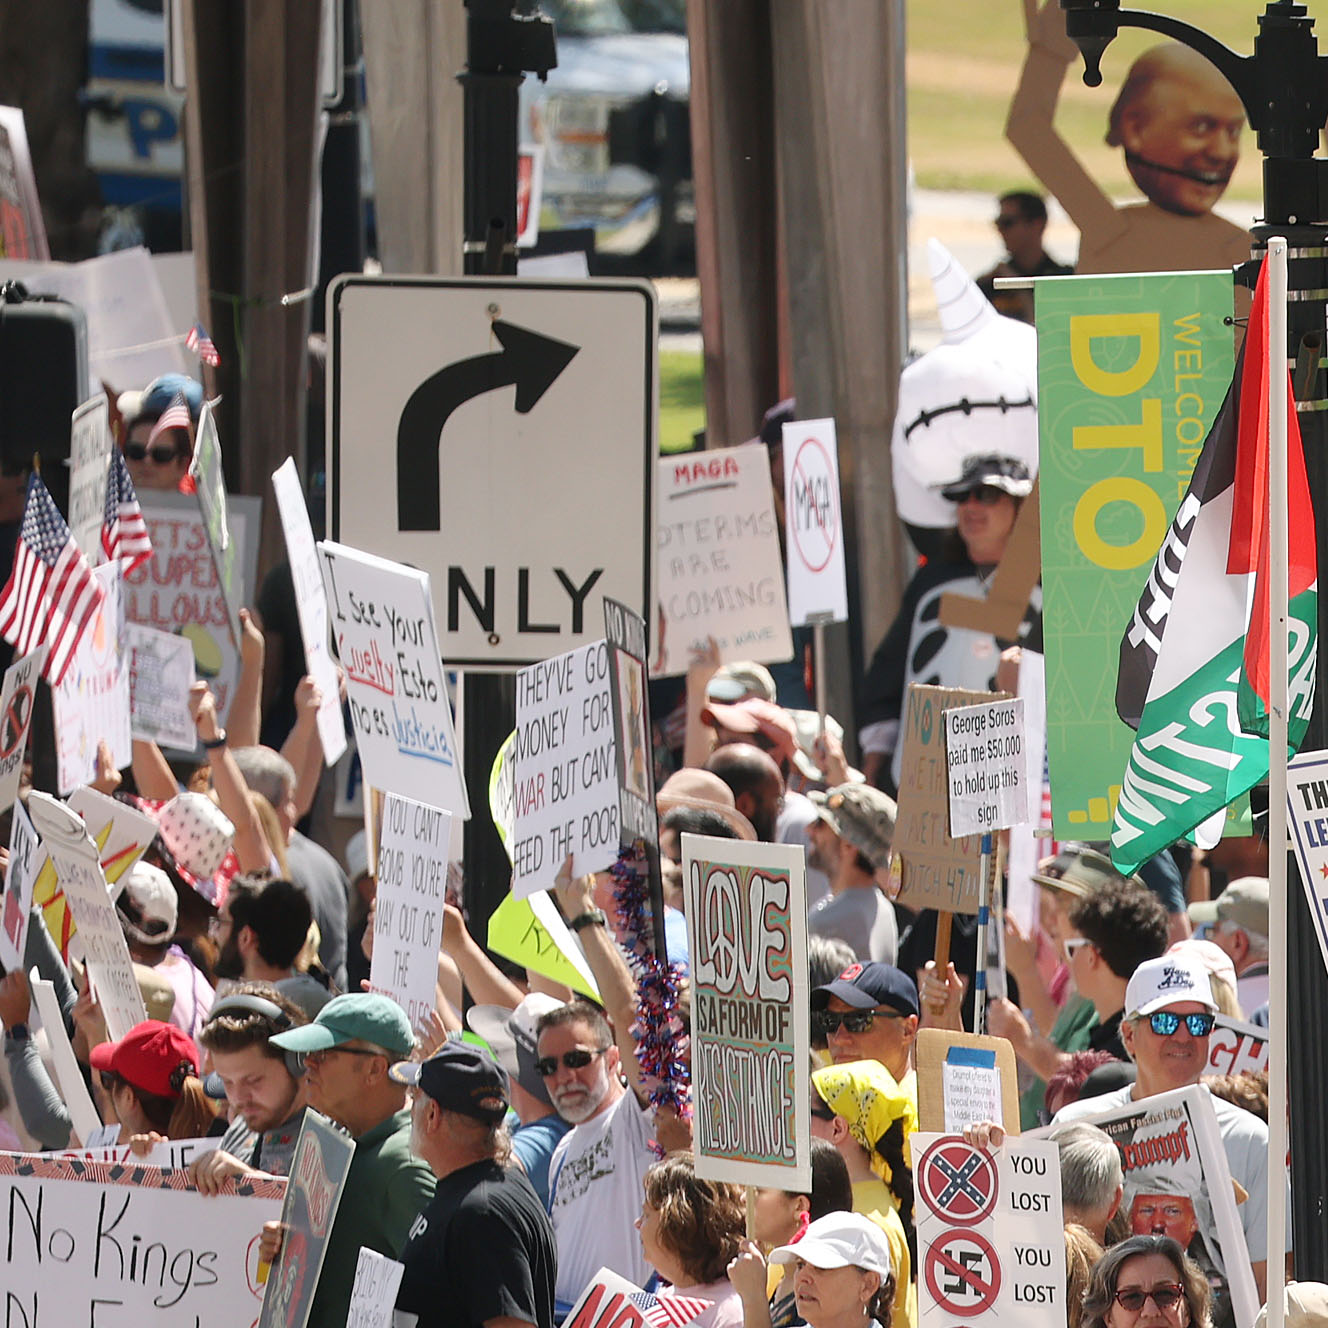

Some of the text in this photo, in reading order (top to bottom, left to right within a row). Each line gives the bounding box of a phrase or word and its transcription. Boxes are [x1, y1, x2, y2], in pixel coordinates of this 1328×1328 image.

[1069, 312, 1168, 570] DTO
[952, 709, 1015, 736] George Soros
[949, 735, 1019, 772] paid me $50,000
[953, 767, 1018, 796] to hold up this
[977, 802, 997, 825] sign
[1010, 1155, 1046, 1176] YOU
[1011, 1191, 1050, 1212] LOST
[6, 1185, 219, 1308] No Kings
[1014, 1246, 1051, 1267] YOU
[1015, 1283, 1056, 1304] LOST
